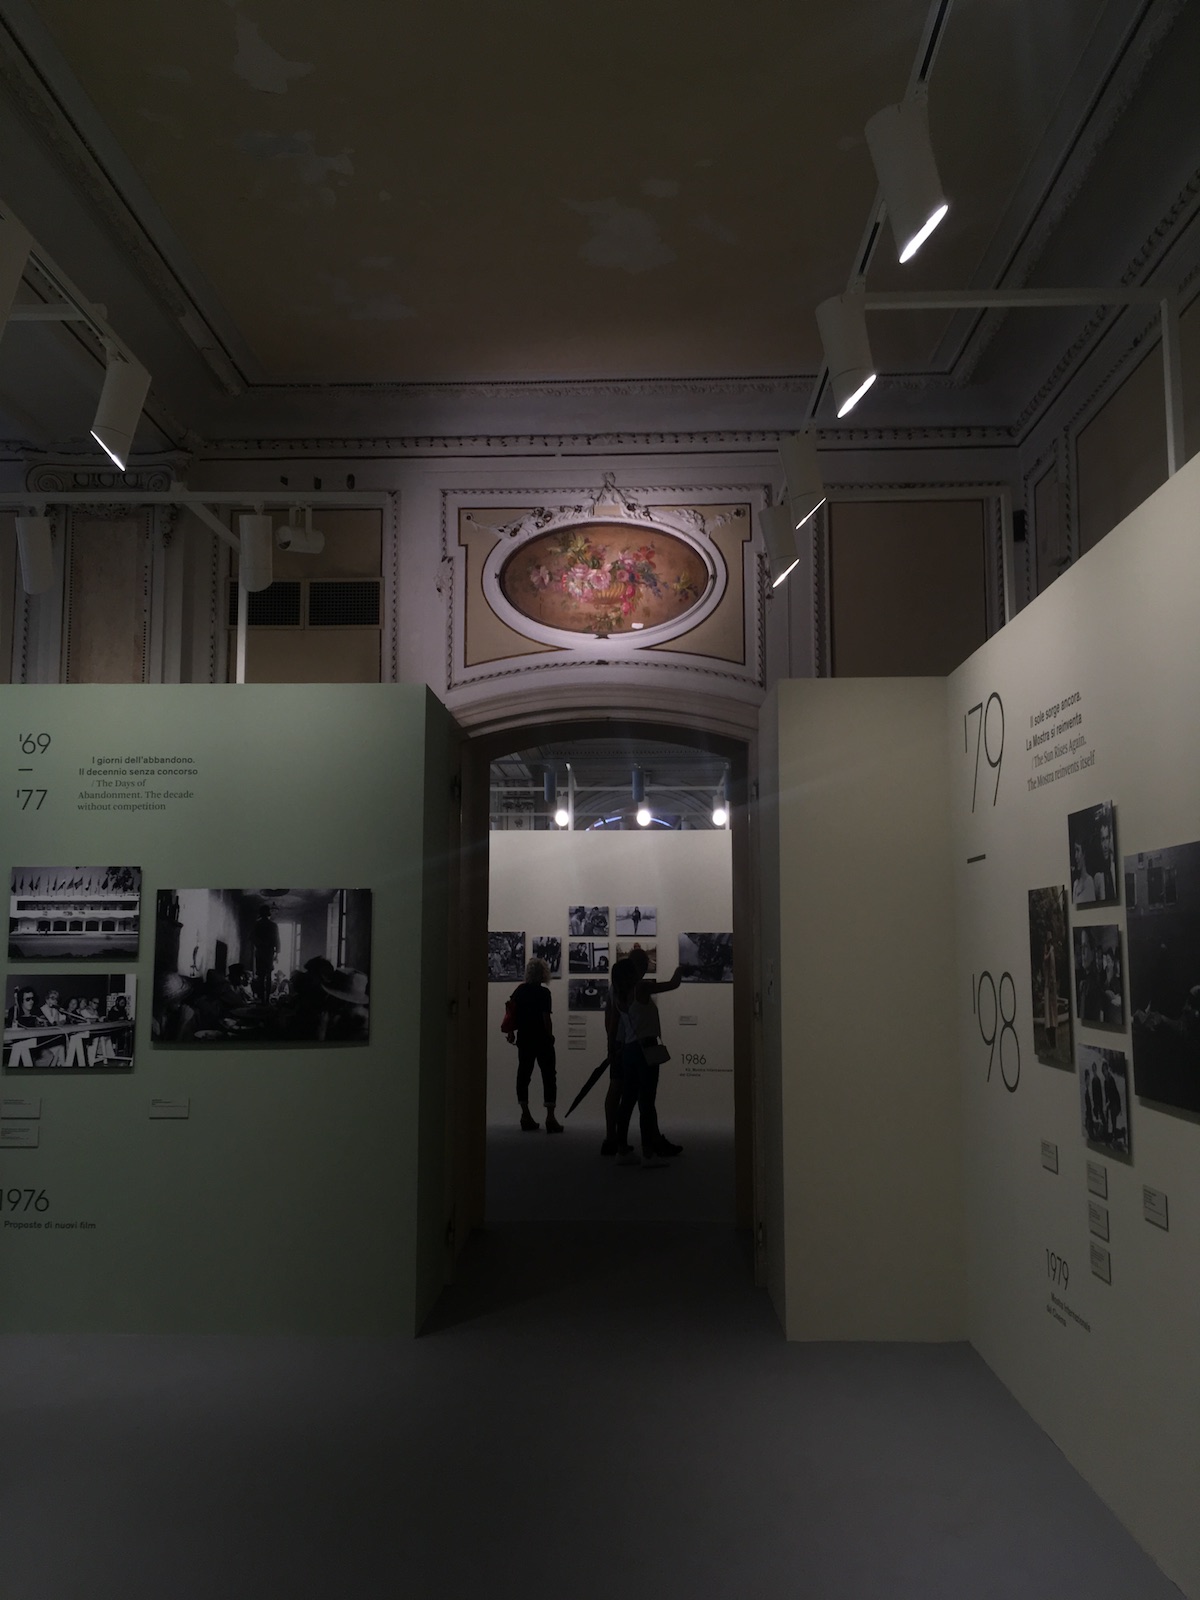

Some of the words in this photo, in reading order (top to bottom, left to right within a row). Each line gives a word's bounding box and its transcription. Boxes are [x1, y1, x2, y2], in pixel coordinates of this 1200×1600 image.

[1034, 710, 1044, 726] sole
[1045, 703, 1060, 719] sorge
[1025, 739, 1032, 751] La
[1033, 730, 1050, 747] Mostra
[1056, 712, 1082, 735] reinventa
[1054, 743, 1068, 758] Rises
[97, 756, 123, 766] giorni
[124, 756, 196, 765] dell'abbandono.
[78, 768, 84, 776] Il
[86, 768, 127, 776] decennio
[157, 768, 199, 776] concorso
[1037, 772, 1054, 788] Mostra
[1054, 761, 1079, 780] reinvents
[1080, 749, 1096, 770] itself
[96, 779, 113, 788] The
[114, 779, 135, 789] Days
[137, 779, 147, 788] of
[78, 791, 143, 800] Abandonment.
[145, 791, 162, 799] The
[163, 790, 194, 799] decade
[77, 802, 111, 811] without
[112, 802, 166, 812] competition
[681, 1053, 706, 1065] 1986
[0, 1188, 49, 1212] 1976
[4, 1220, 42, 1230] Proposte
[44, 1220, 53, 1229] di
[55, 1221, 77, 1229] nuovi
[80, 1221, 96, 1229] film
[1045, 1248, 1069, 1290] 1979
